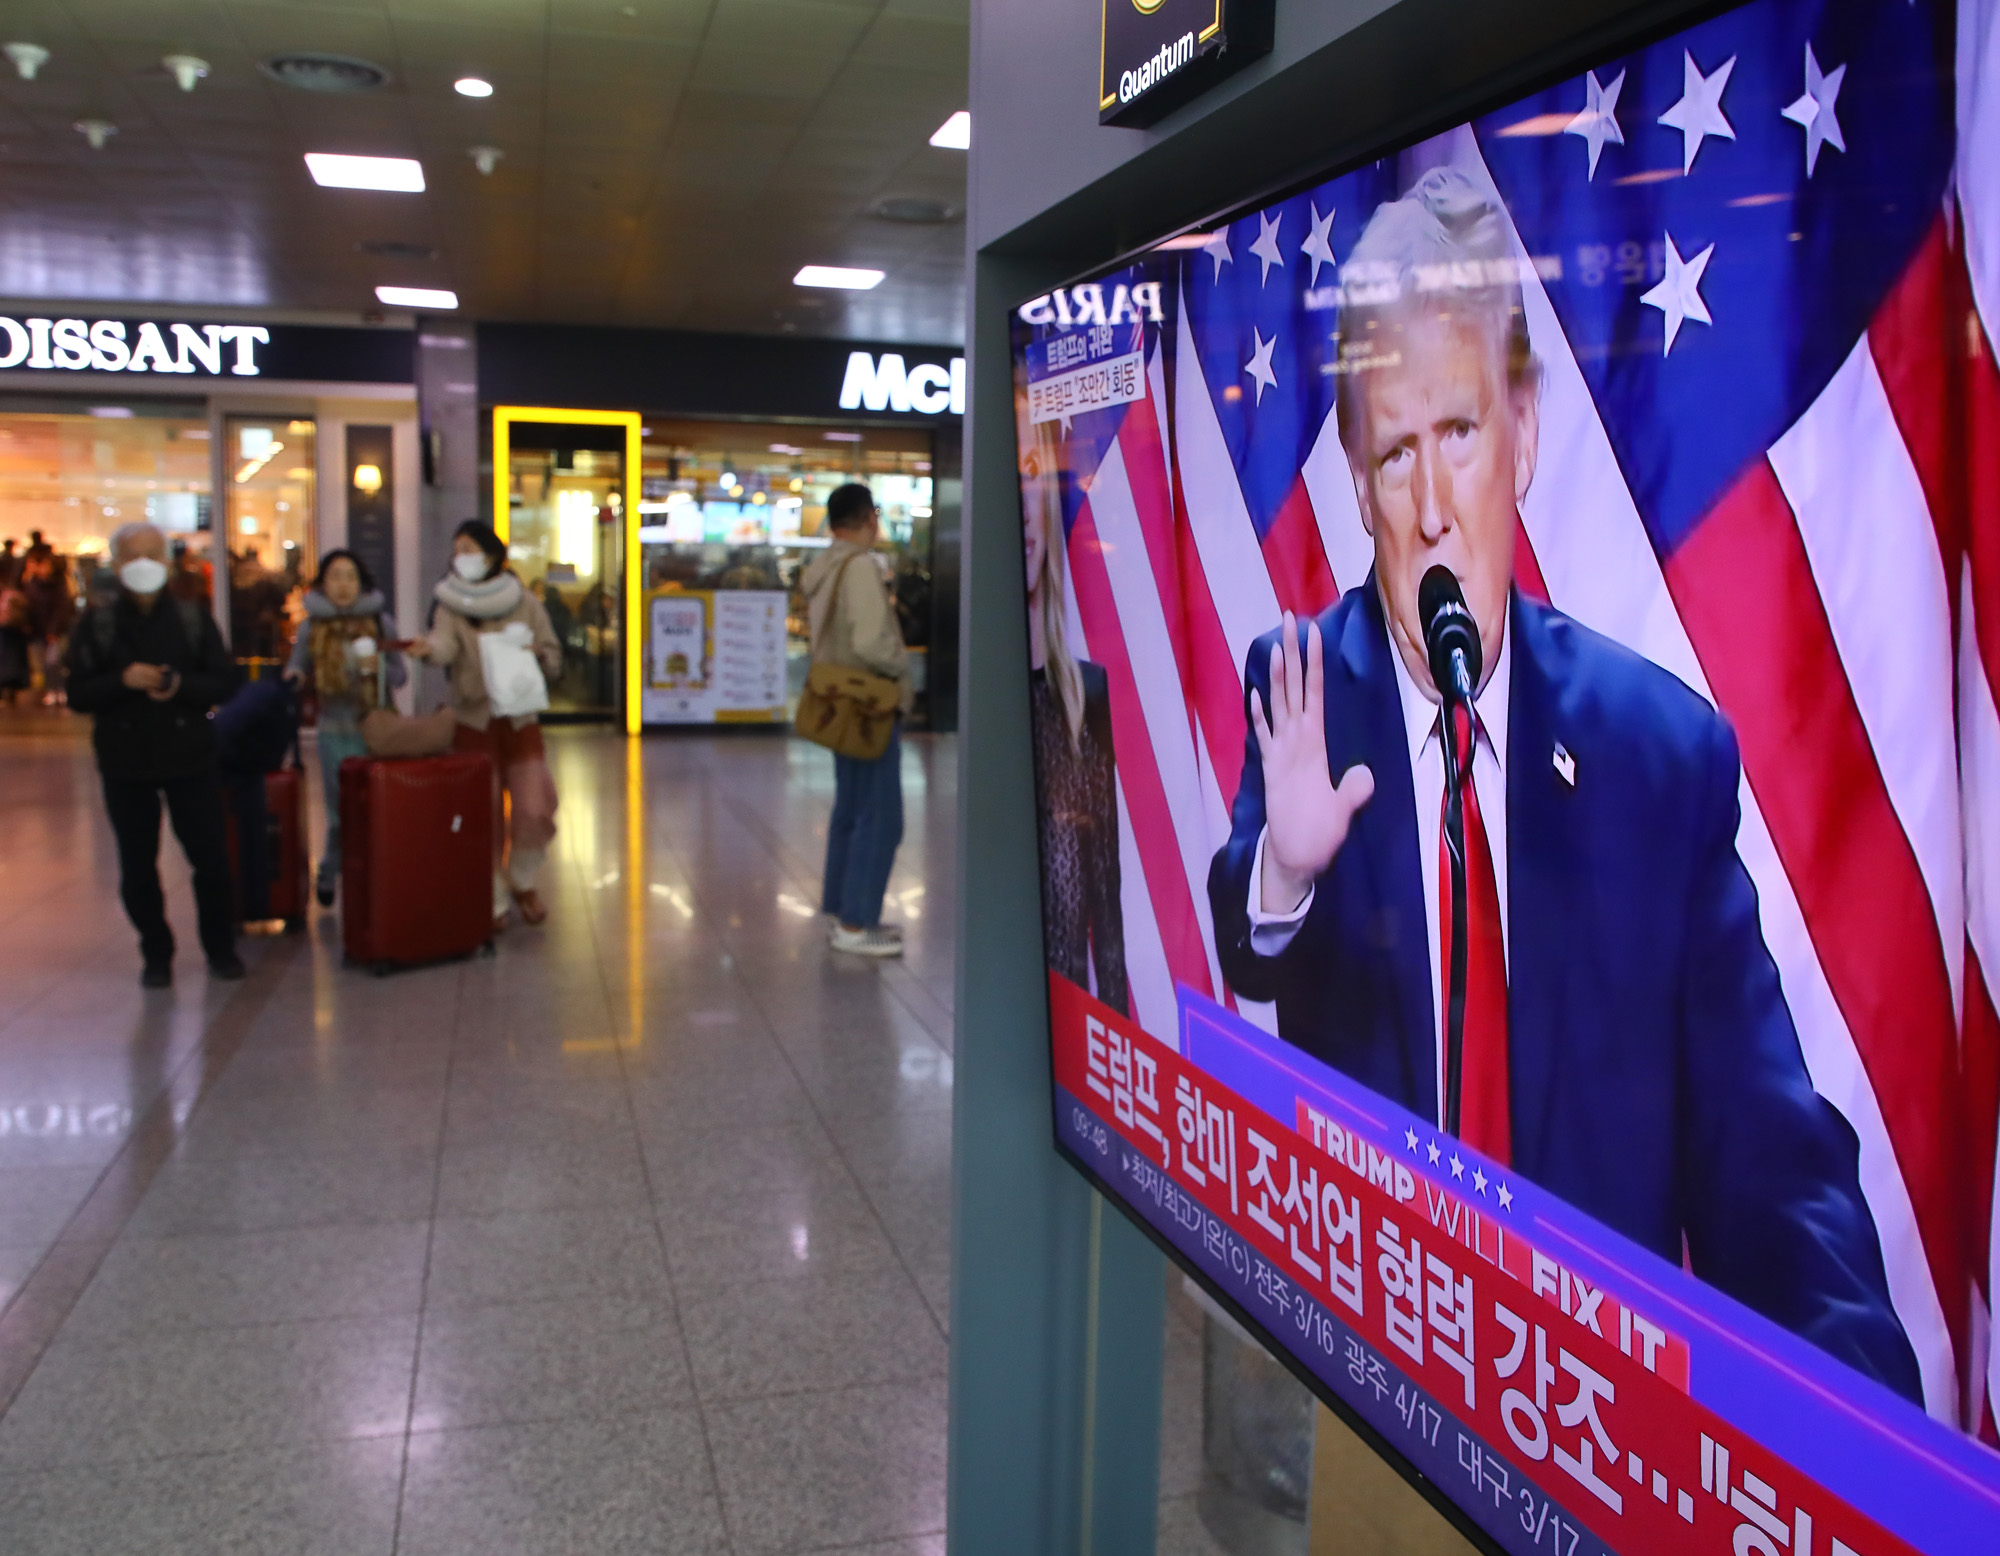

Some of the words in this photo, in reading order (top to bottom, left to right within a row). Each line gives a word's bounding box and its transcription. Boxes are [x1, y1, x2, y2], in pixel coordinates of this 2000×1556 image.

[1119, 31, 1193, 104] Quantum
[1046, 334, 1087, 372] 트럼프의
[1085, 1013, 1170, 1170] 트럼프,
[1174, 1073, 1239, 1216] 한미
[1246, 1127, 1364, 1318] 조선업
[1375, 1215, 1476, 1412] 협력
[1307, 1105, 1416, 1203] TRUMP
[1424, 1178, 1519, 1282] WILL
[1531, 1247, 1605, 1339] FIX
[1619, 1303, 1666, 1374] IT
[1254, 1257, 1292, 1316] 전주
[1294, 1294, 1335, 1356] 3/16
[1344, 1334, 1390, 1402] 광주
[1394, 1383, 1442, 1448] 4/17
[1457, 1431, 1513, 1509] 대구
[1519, 1487, 1581, 1556] 3/17
